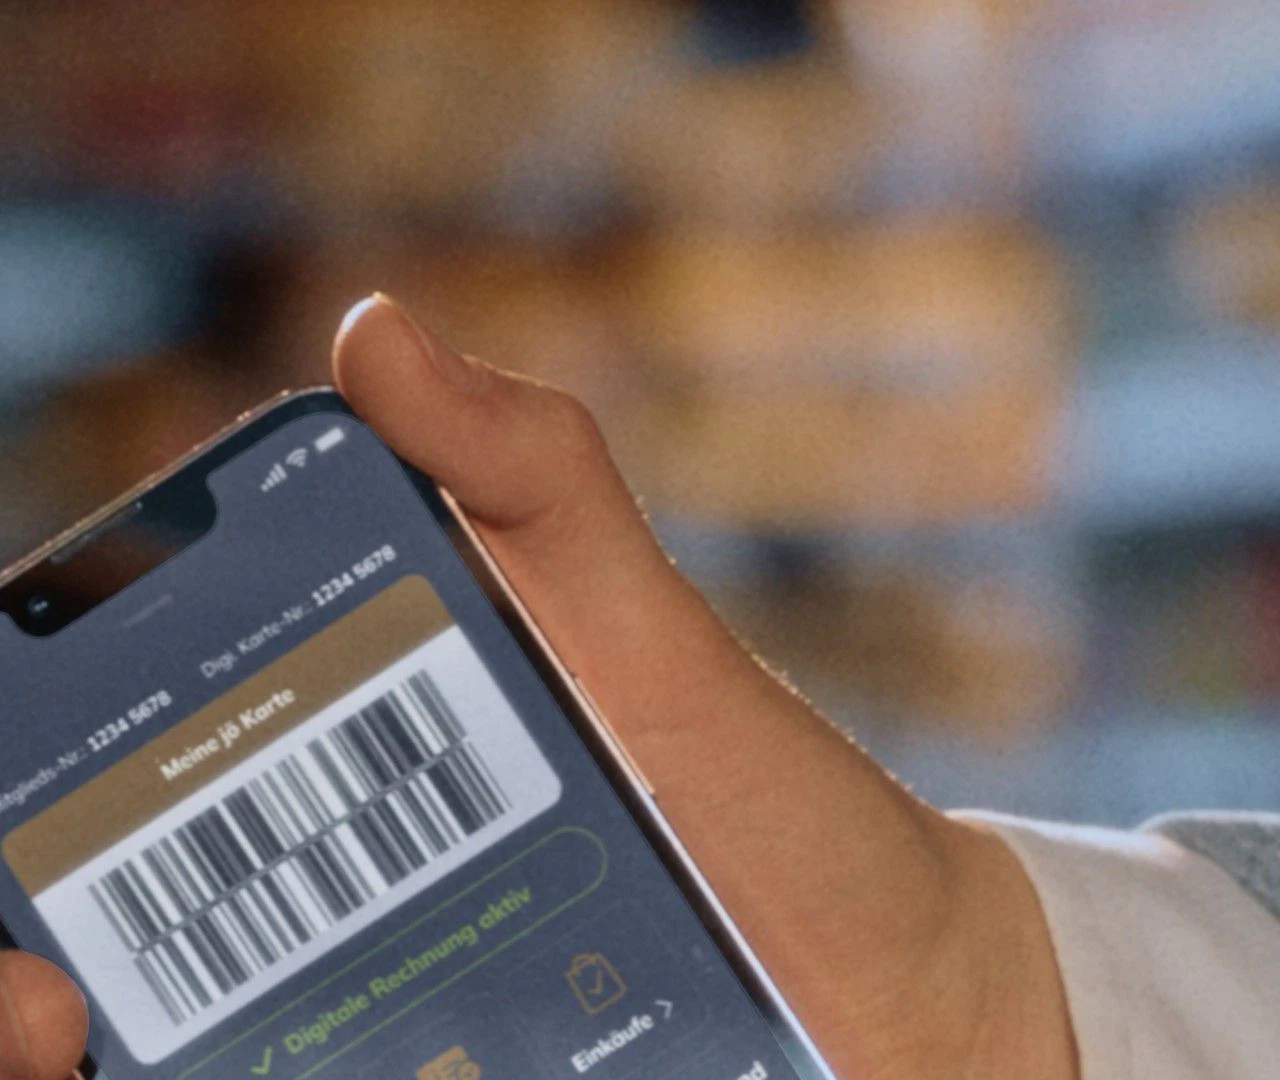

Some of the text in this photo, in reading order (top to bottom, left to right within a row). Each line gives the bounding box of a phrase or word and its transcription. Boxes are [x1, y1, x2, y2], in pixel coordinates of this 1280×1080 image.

[200, 649, 238, 679] Digi.
[311, 571, 355, 607] 1234
[351, 544, 397, 580] 5678
[87, 716, 130, 752] 1234
[128, 689, 173, 725] 5678
[159, 688, 296, 780] Meine jö Karte
[283, 886, 532, 1055] Digitale Rechnung aktiv
[569, 1011, 656, 1075] Einkäufe
